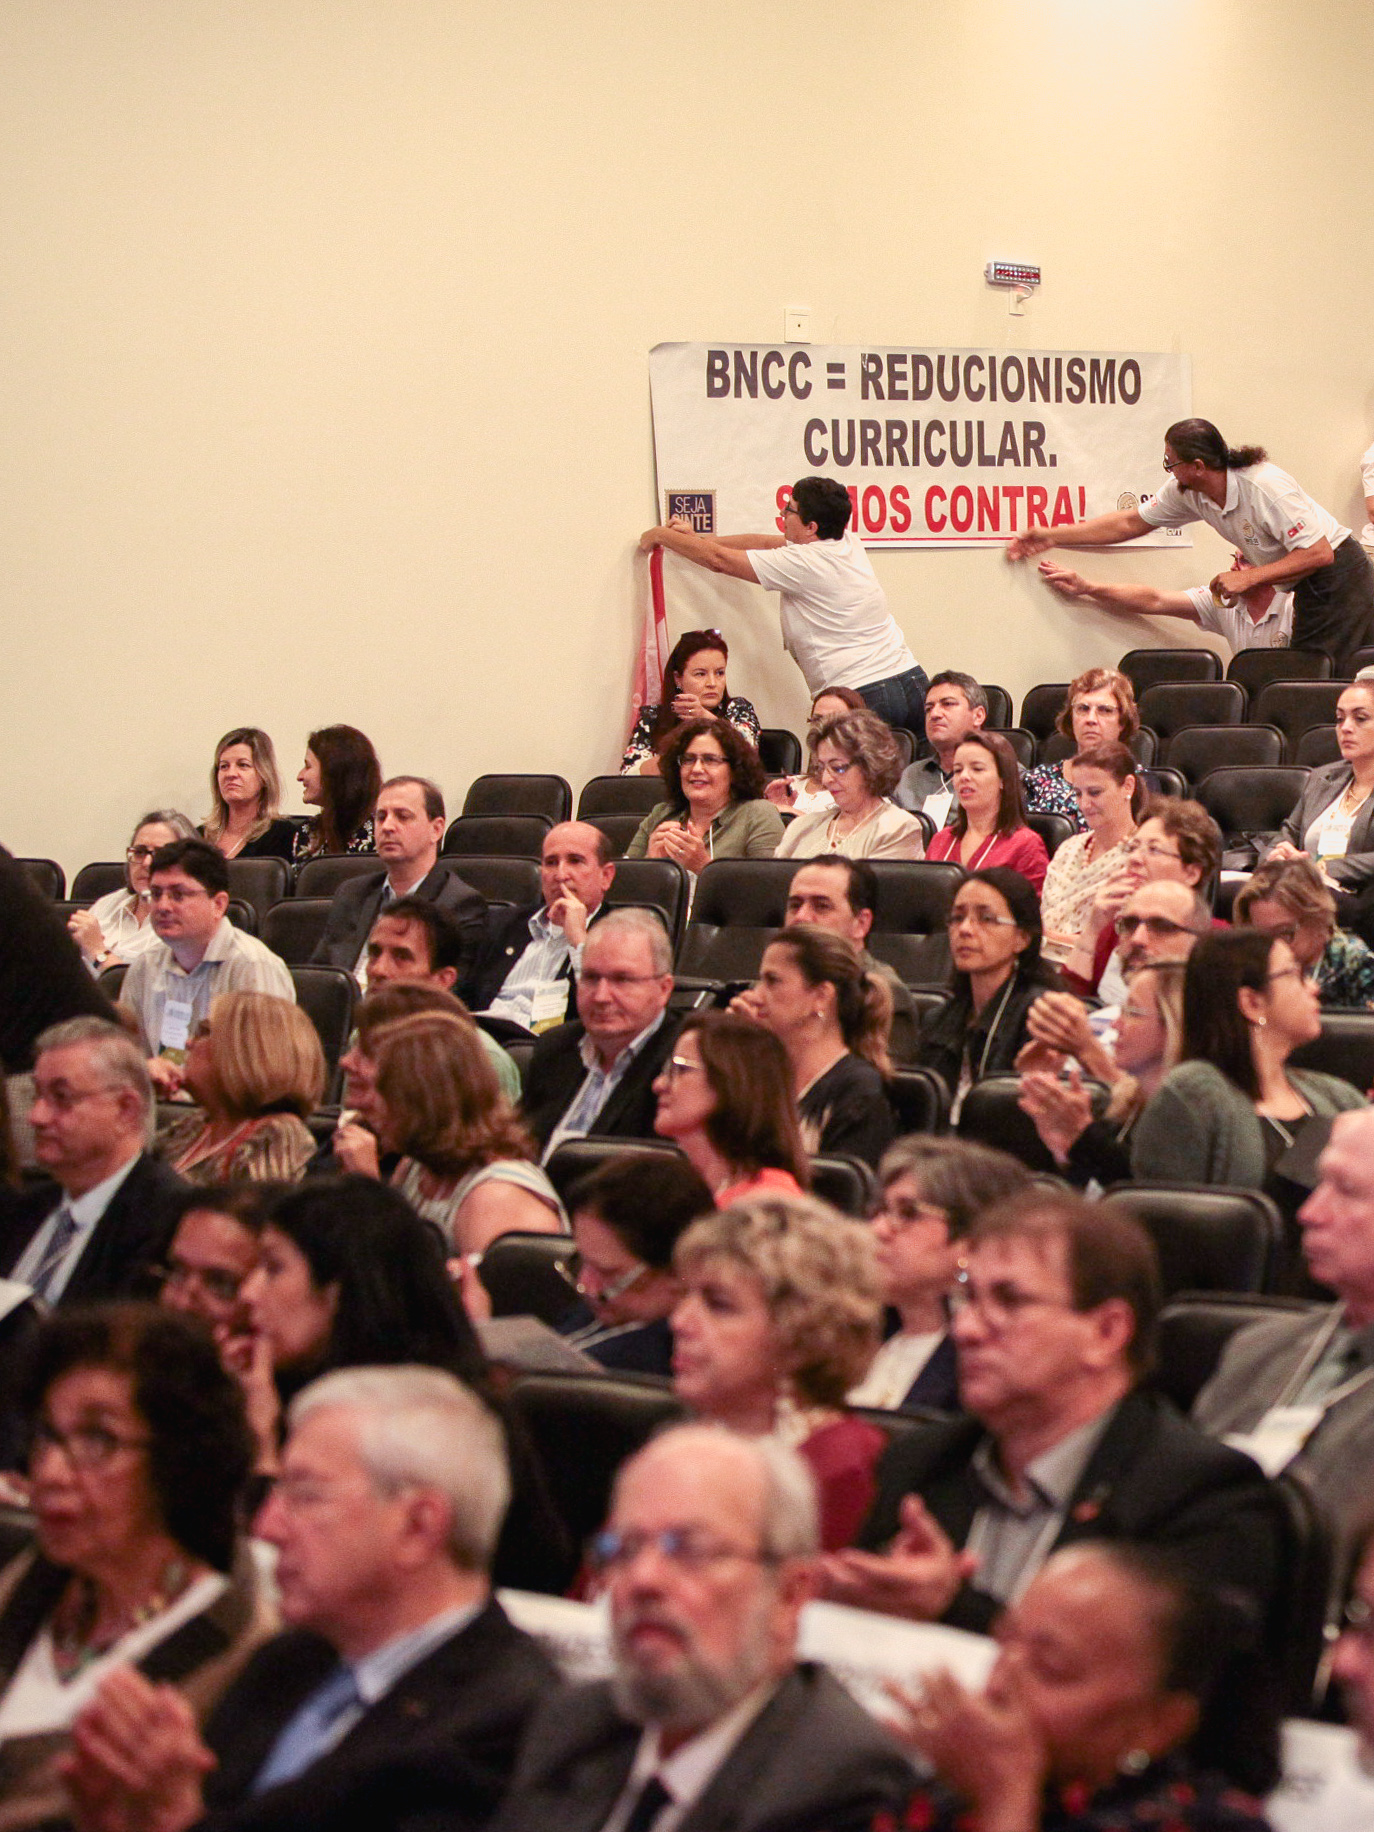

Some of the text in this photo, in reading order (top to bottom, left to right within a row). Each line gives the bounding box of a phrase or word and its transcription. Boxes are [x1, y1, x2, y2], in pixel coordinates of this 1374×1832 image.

[706, 350, 813, 400] BNCC
[860, 353, 1142, 405] REDUCIONISMO
[803, 418, 1057, 468] CURRICULAR.
[674, 496, 707, 514] SEJA
[775, 484, 1086, 534] SOS CONTRA!
